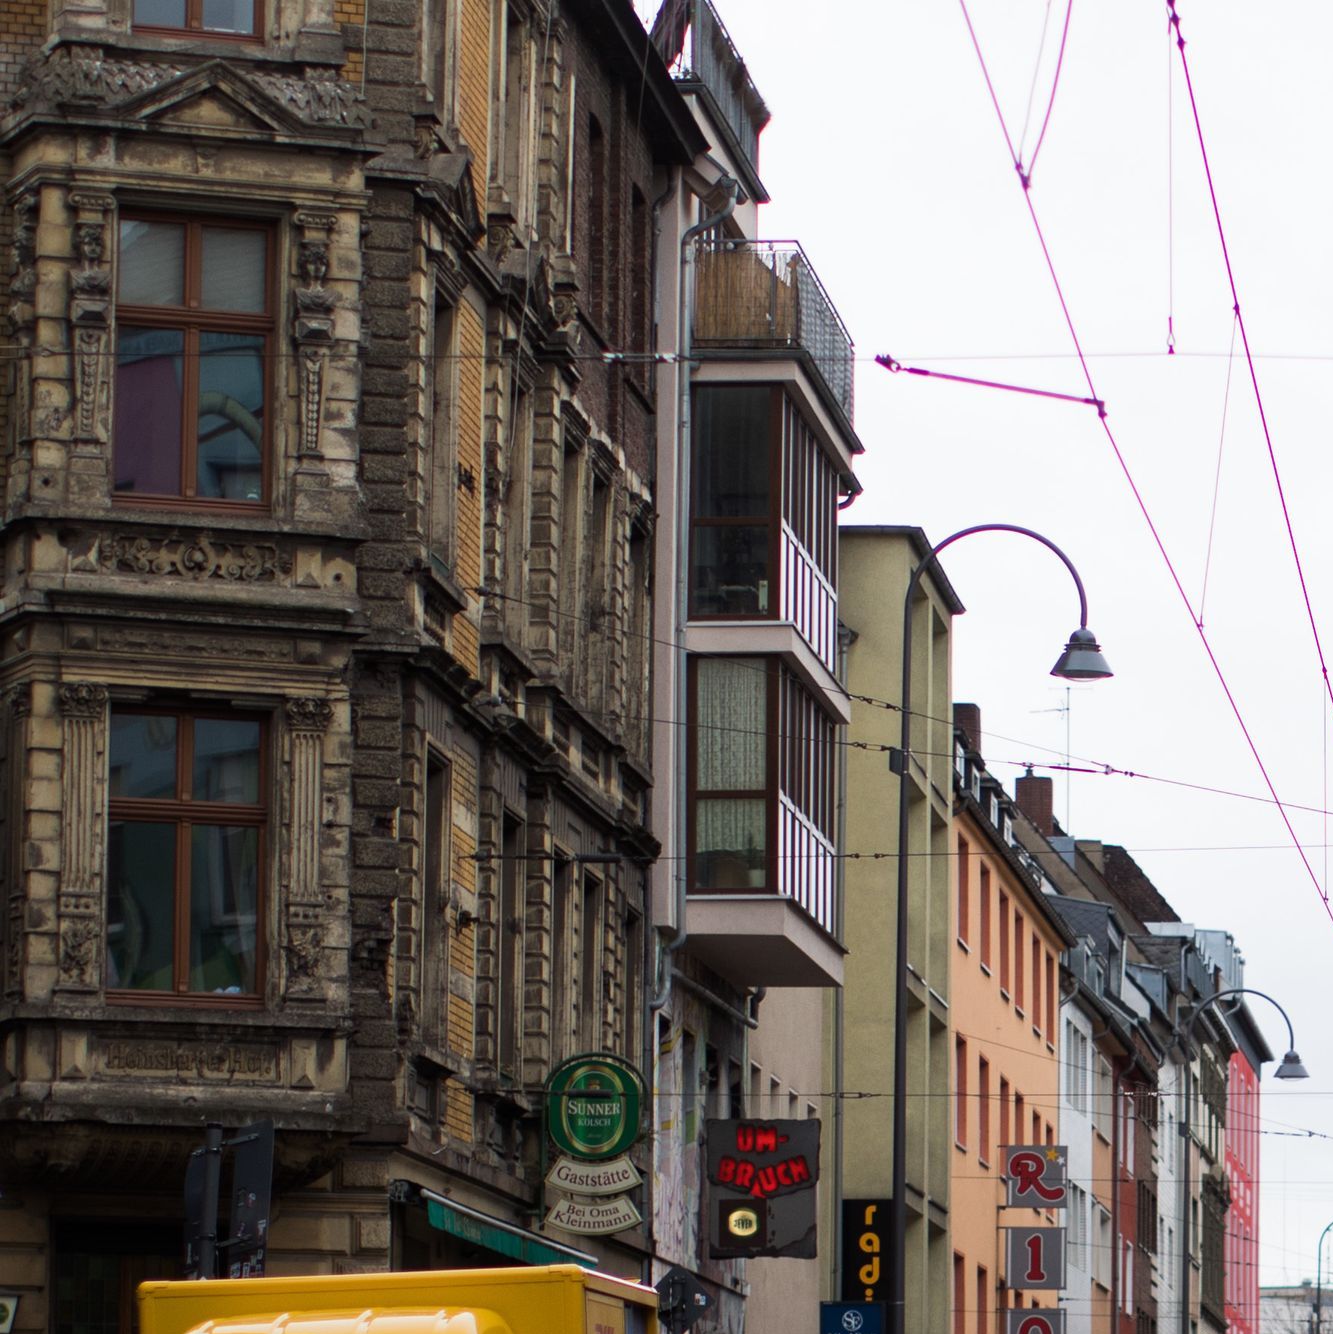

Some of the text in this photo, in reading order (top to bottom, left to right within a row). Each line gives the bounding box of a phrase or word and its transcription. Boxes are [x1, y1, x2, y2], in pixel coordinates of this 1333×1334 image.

[556, 1166, 631, 1187] Gaststätte
[554, 1210, 632, 1230] Kleinmann
[567, 1204, 620, 1218] Bei Oma
